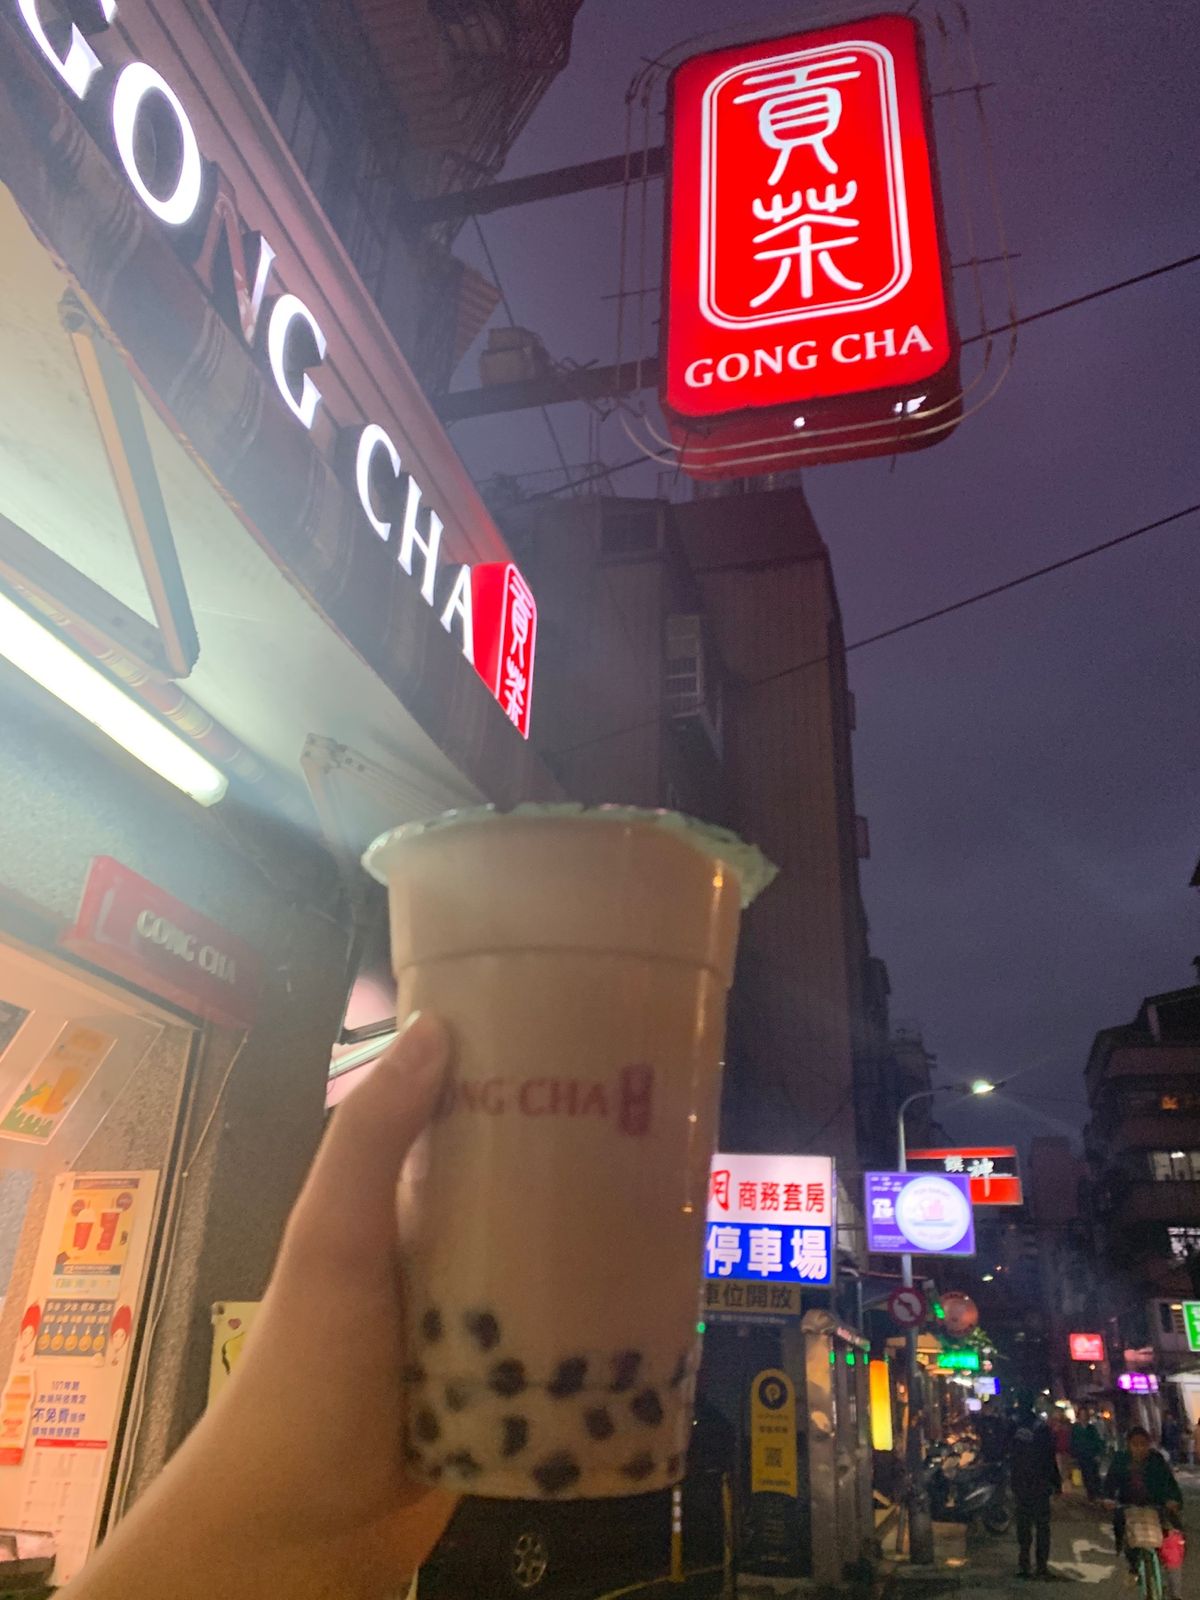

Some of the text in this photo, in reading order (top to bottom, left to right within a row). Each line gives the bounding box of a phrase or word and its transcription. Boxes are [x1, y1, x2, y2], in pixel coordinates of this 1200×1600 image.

[732, 56, 864, 308] 貢茶
[684, 325, 933, 389] GONG CHA
[356, 424, 476, 665] CHA
[504, 576, 533, 727] 貢茶
[518, 1077, 608, 1118] CHA
[738, 1181, 825, 1213] 商務套房
[706, 1225, 828, 1280] 停車場
